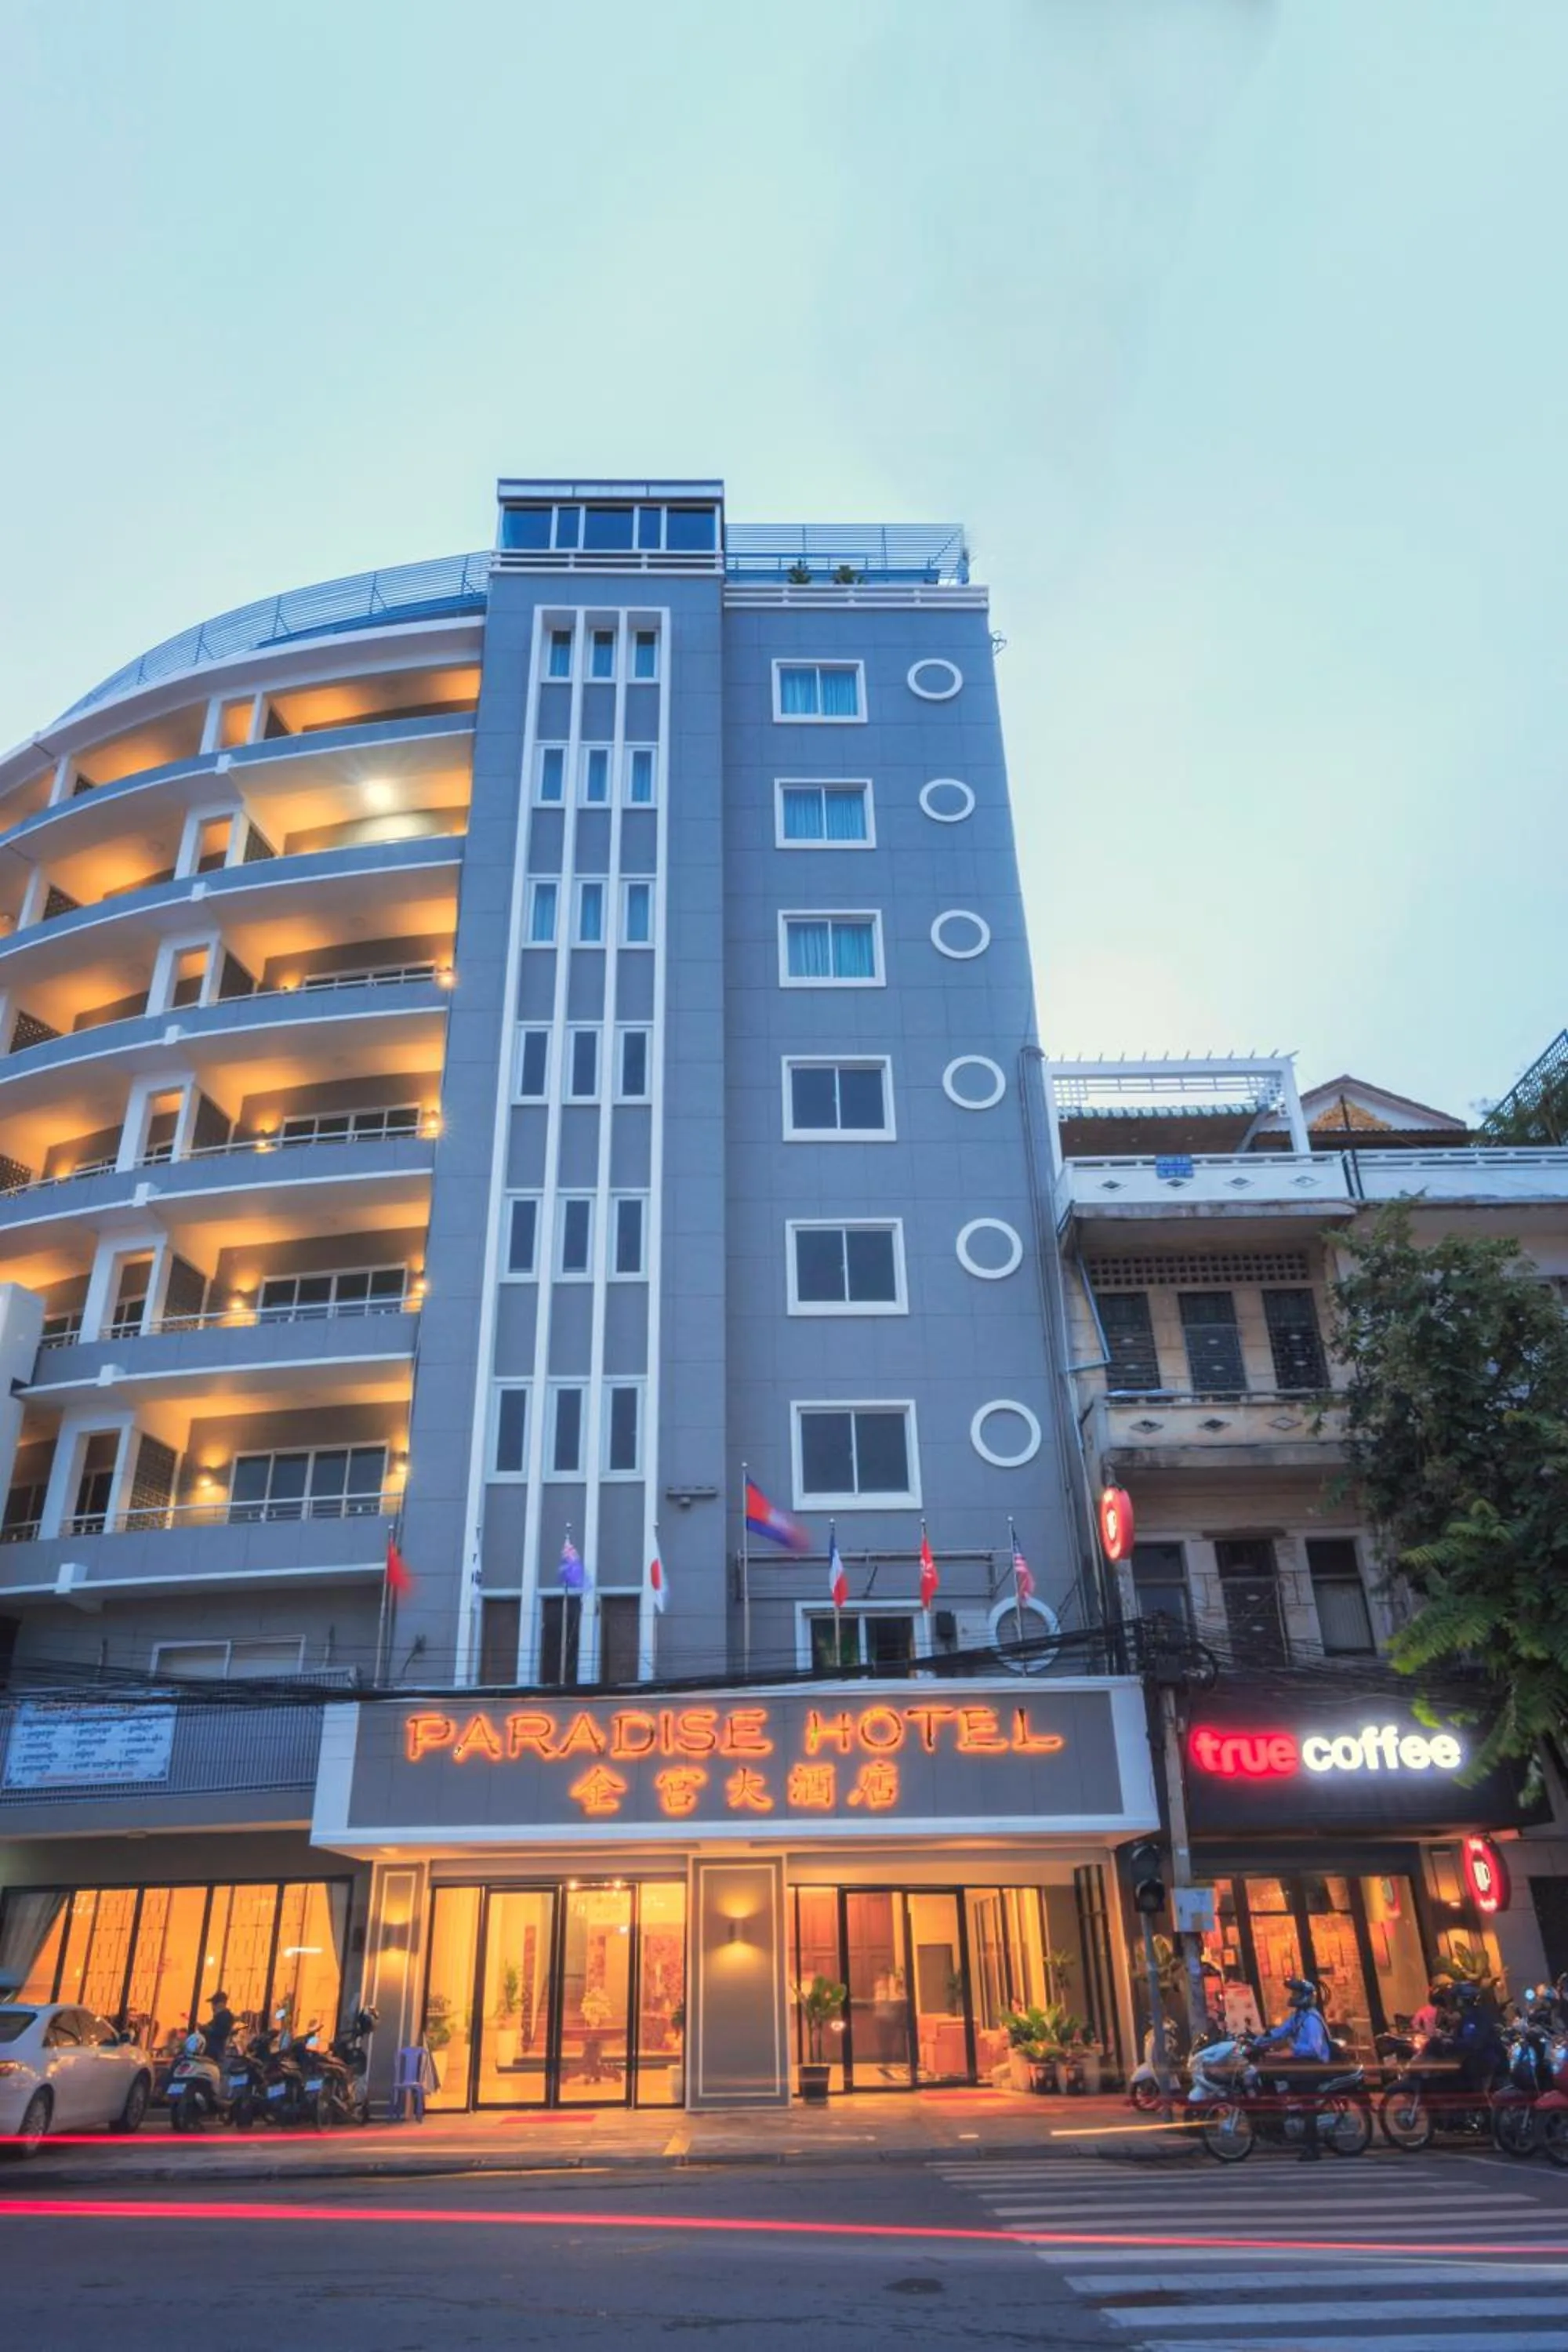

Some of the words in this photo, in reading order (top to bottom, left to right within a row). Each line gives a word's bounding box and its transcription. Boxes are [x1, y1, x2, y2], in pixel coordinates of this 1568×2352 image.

[407, 1708, 774, 1762] PARADISE
[805, 1705, 1064, 1757] HOTEL
[1193, 1730, 1298, 1774] true
[1301, 1725, 1462, 1772] coffee
